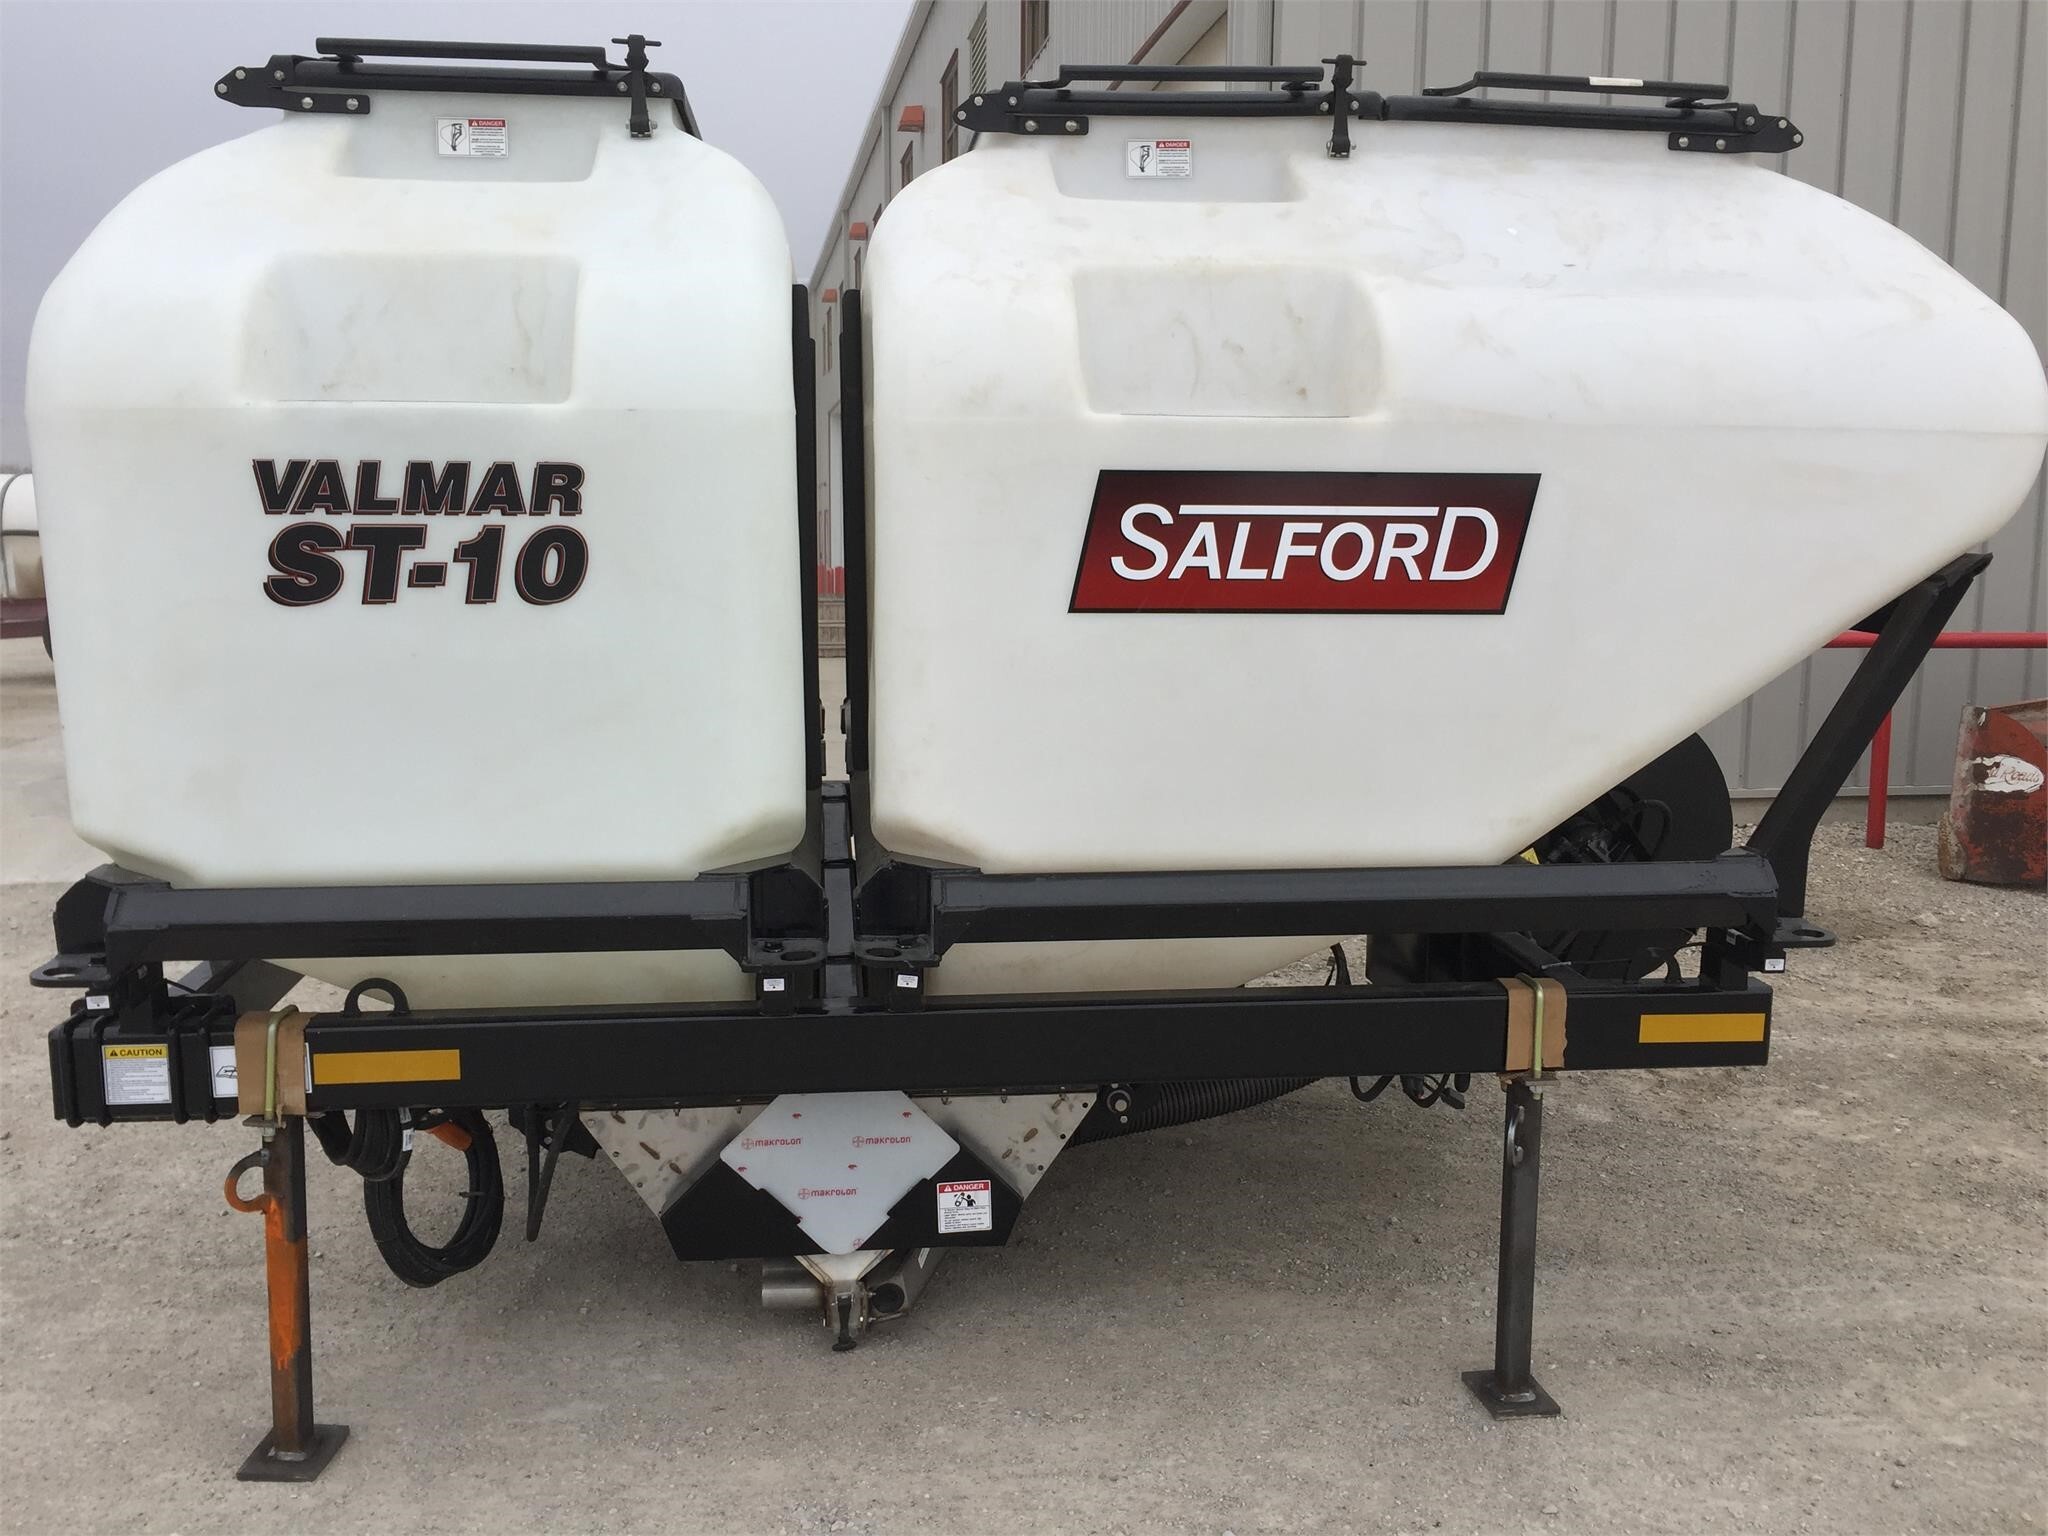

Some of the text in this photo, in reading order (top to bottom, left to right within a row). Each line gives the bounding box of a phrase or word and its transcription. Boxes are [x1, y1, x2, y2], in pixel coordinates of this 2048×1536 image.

[252, 459, 585, 516] VALMAR
[263, 521, 589, 607] ST-10
[120, 1049, 162, 1057] CAUTION
[953, 1183, 984, 1191] DANGER
